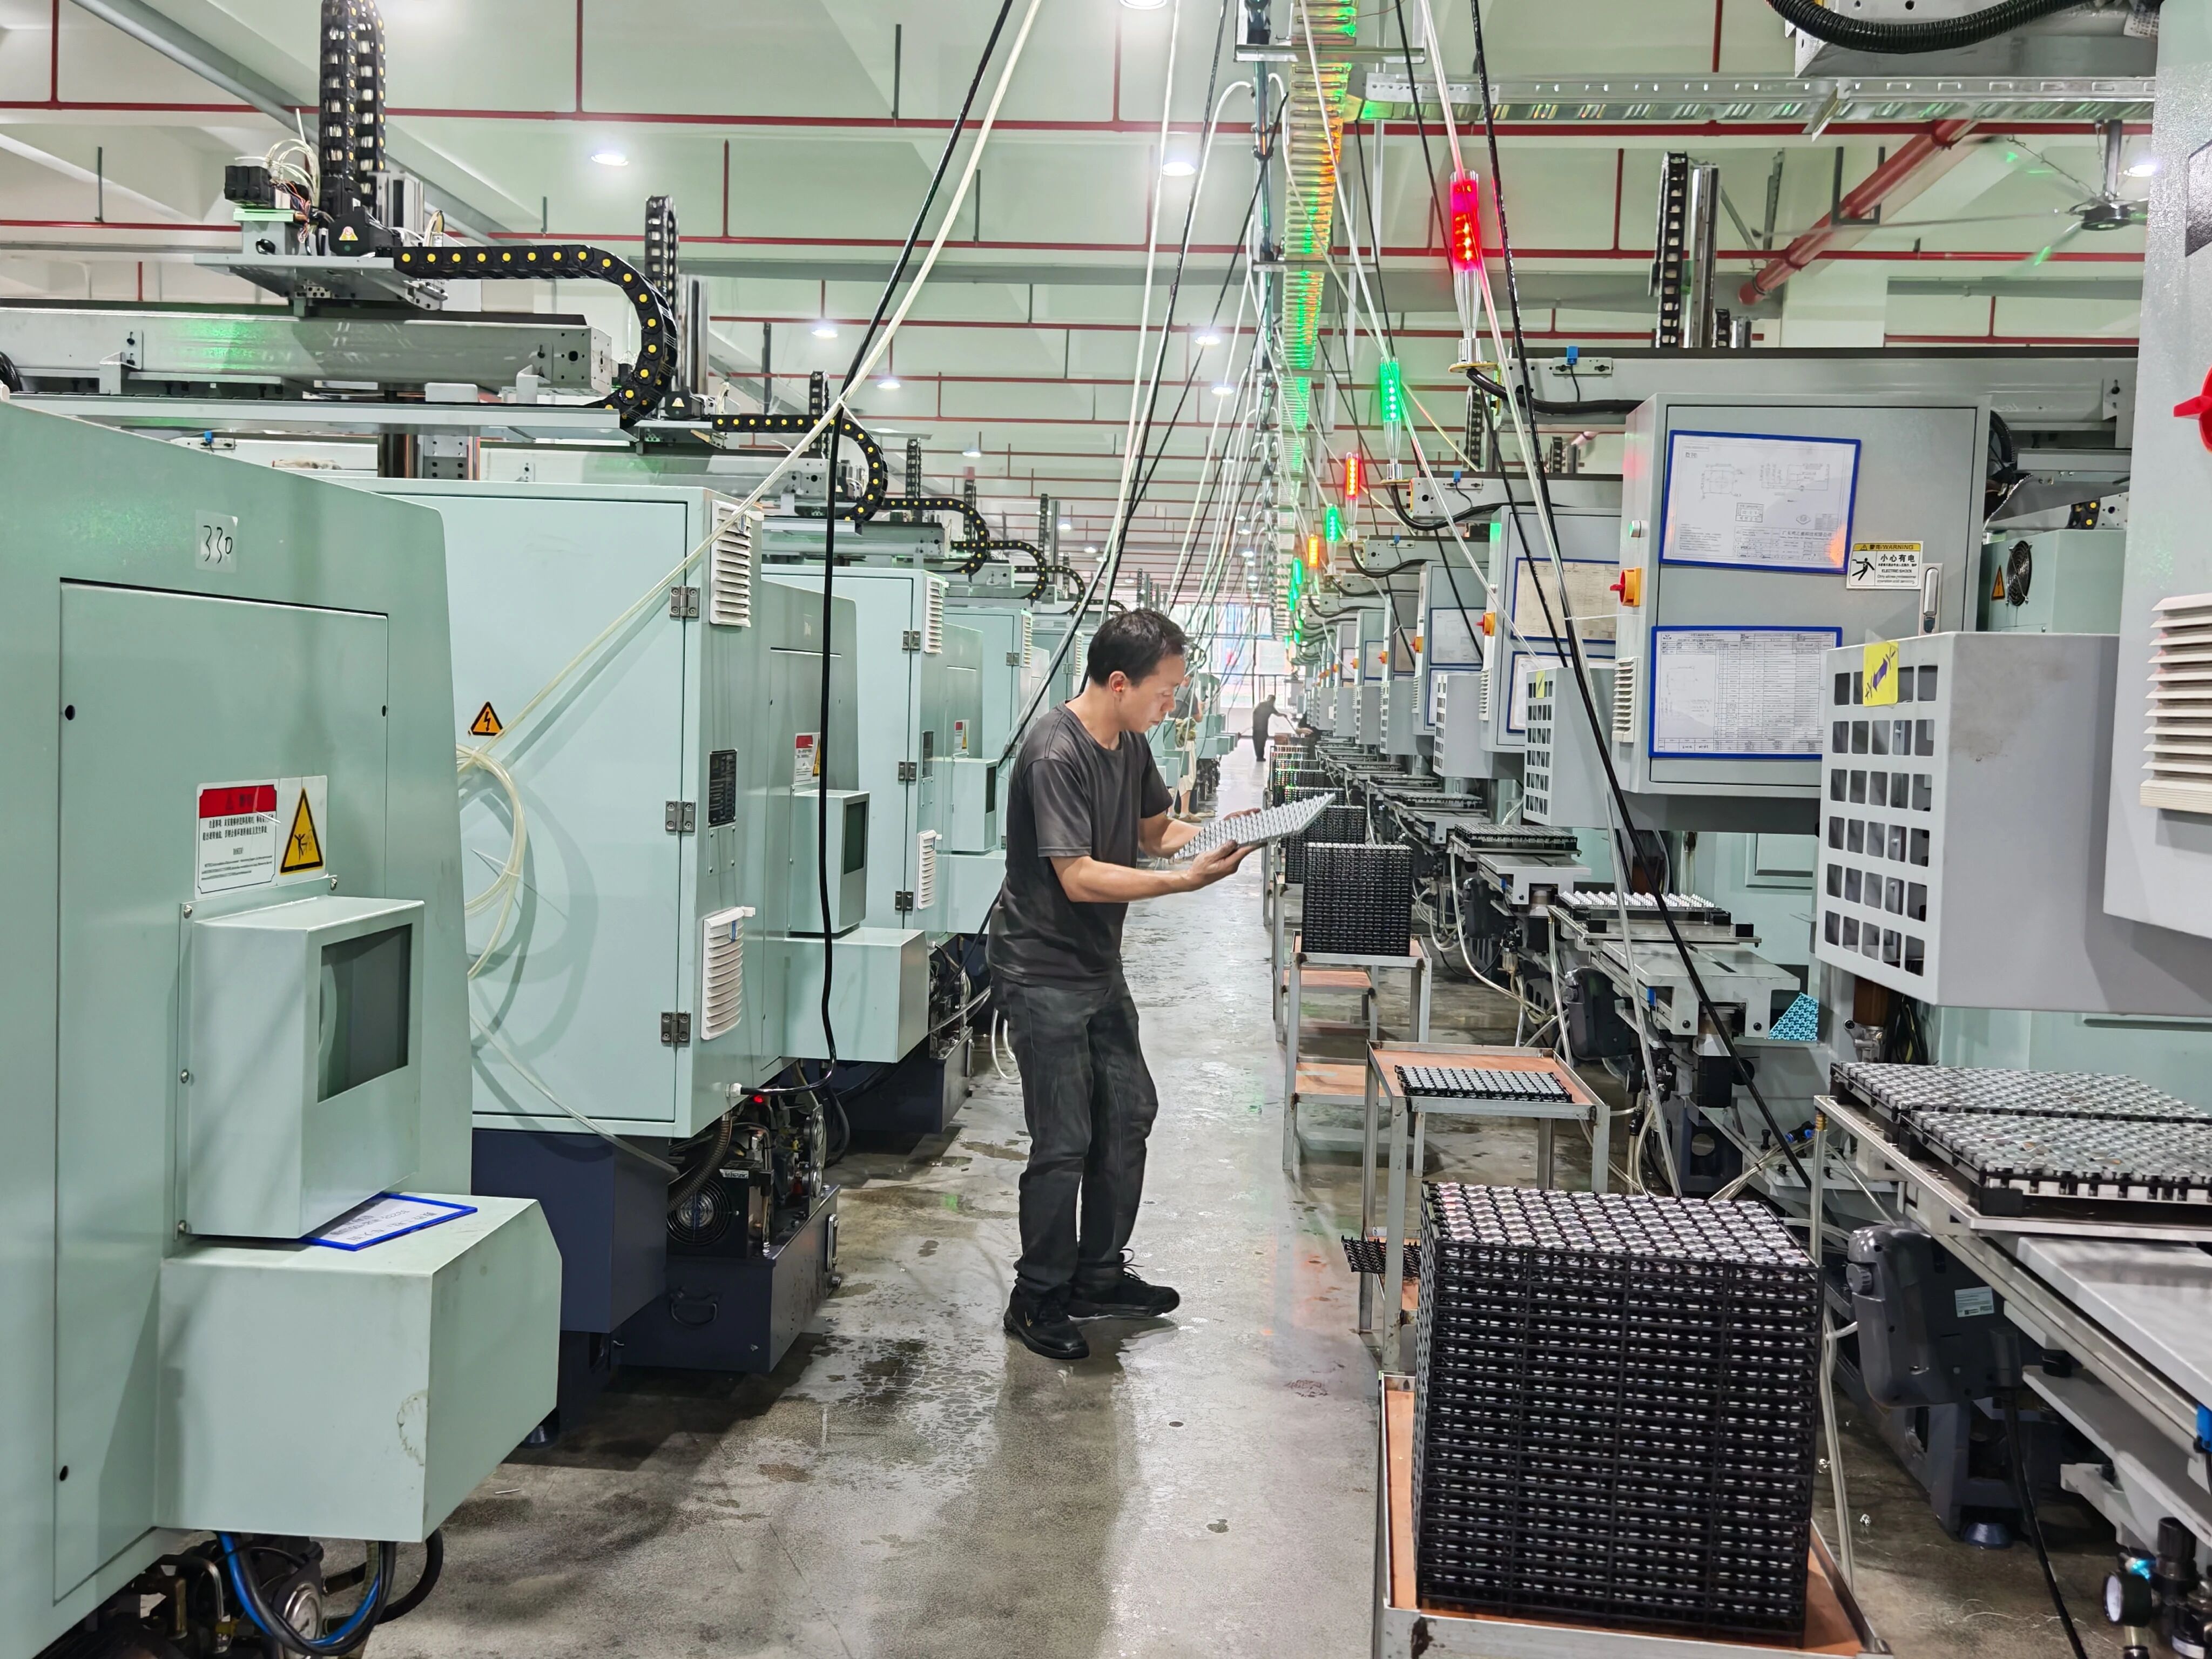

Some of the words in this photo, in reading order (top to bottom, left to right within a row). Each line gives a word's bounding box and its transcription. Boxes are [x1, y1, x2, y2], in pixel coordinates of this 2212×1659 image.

[203, 525, 233, 564] 330
[1880, 554, 1915, 562] 小心有电
